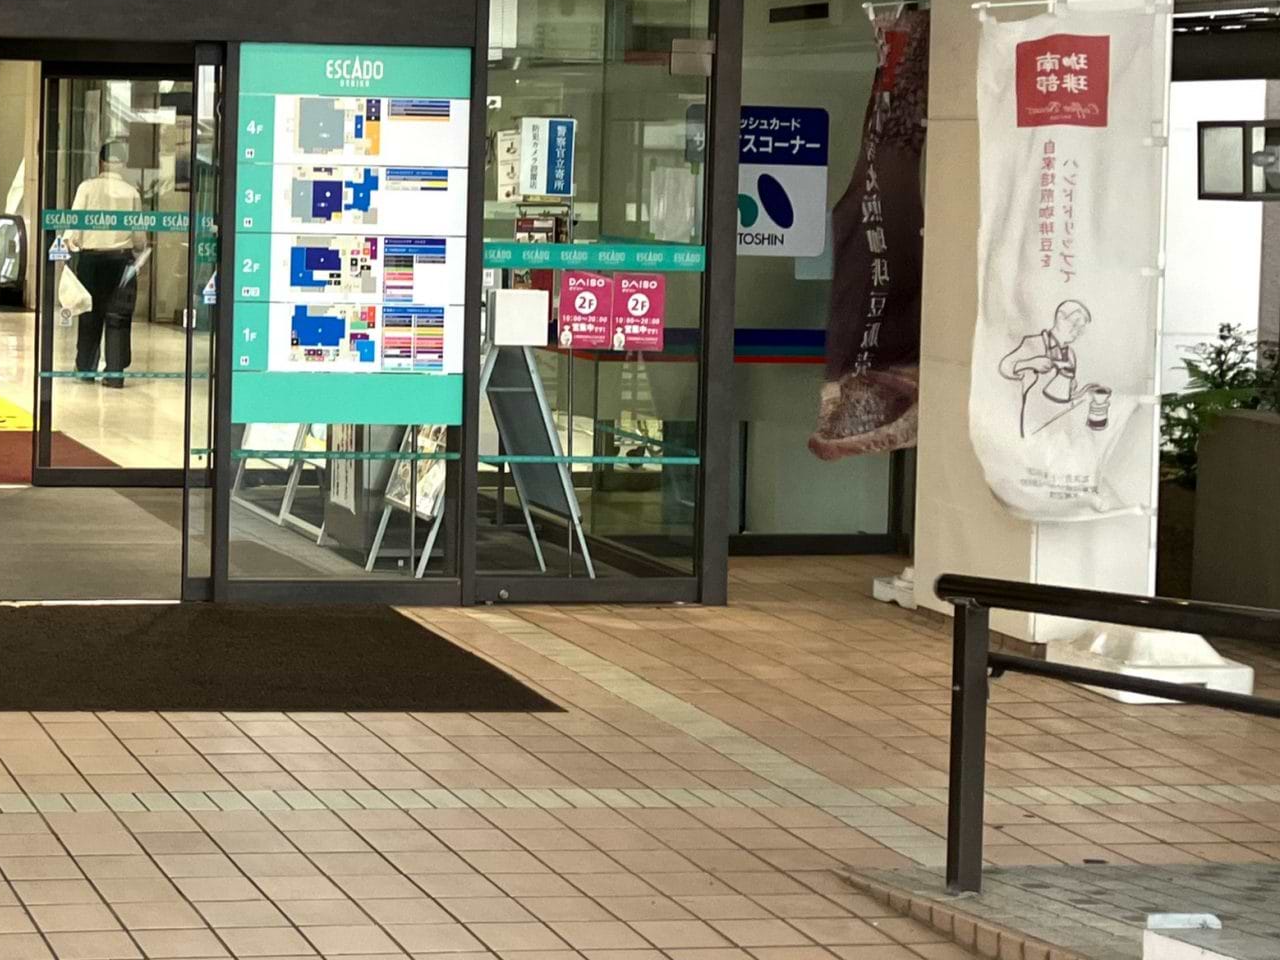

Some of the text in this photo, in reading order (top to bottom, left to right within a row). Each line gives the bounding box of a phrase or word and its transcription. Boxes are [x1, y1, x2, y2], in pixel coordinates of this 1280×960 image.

[325, 56, 384, 80] ESCADO
[246, 120, 263, 135] 4F
[739, 134, 821, 155] スコーナー
[553, 125, 568, 191] 警察官立寄所
[244, 189, 261, 204] 3F
[45, 213, 79, 226] ESCADO
[85, 213, 118, 226] ESCADO
[124, 213, 157, 227] ESCADO
[522, 248, 550, 261] ESCADO
[561, 249, 588, 261] ESCADO
[598, 249, 625, 262] ESCADO
[636, 250, 663, 262] ESCADO
[673, 250, 701, 263] ESCADO
[242, 259, 260, 273] 2F
[579, 296, 595, 310] 2F
[631, 297, 648, 311] 2F
[242, 328, 257, 342] 1F
